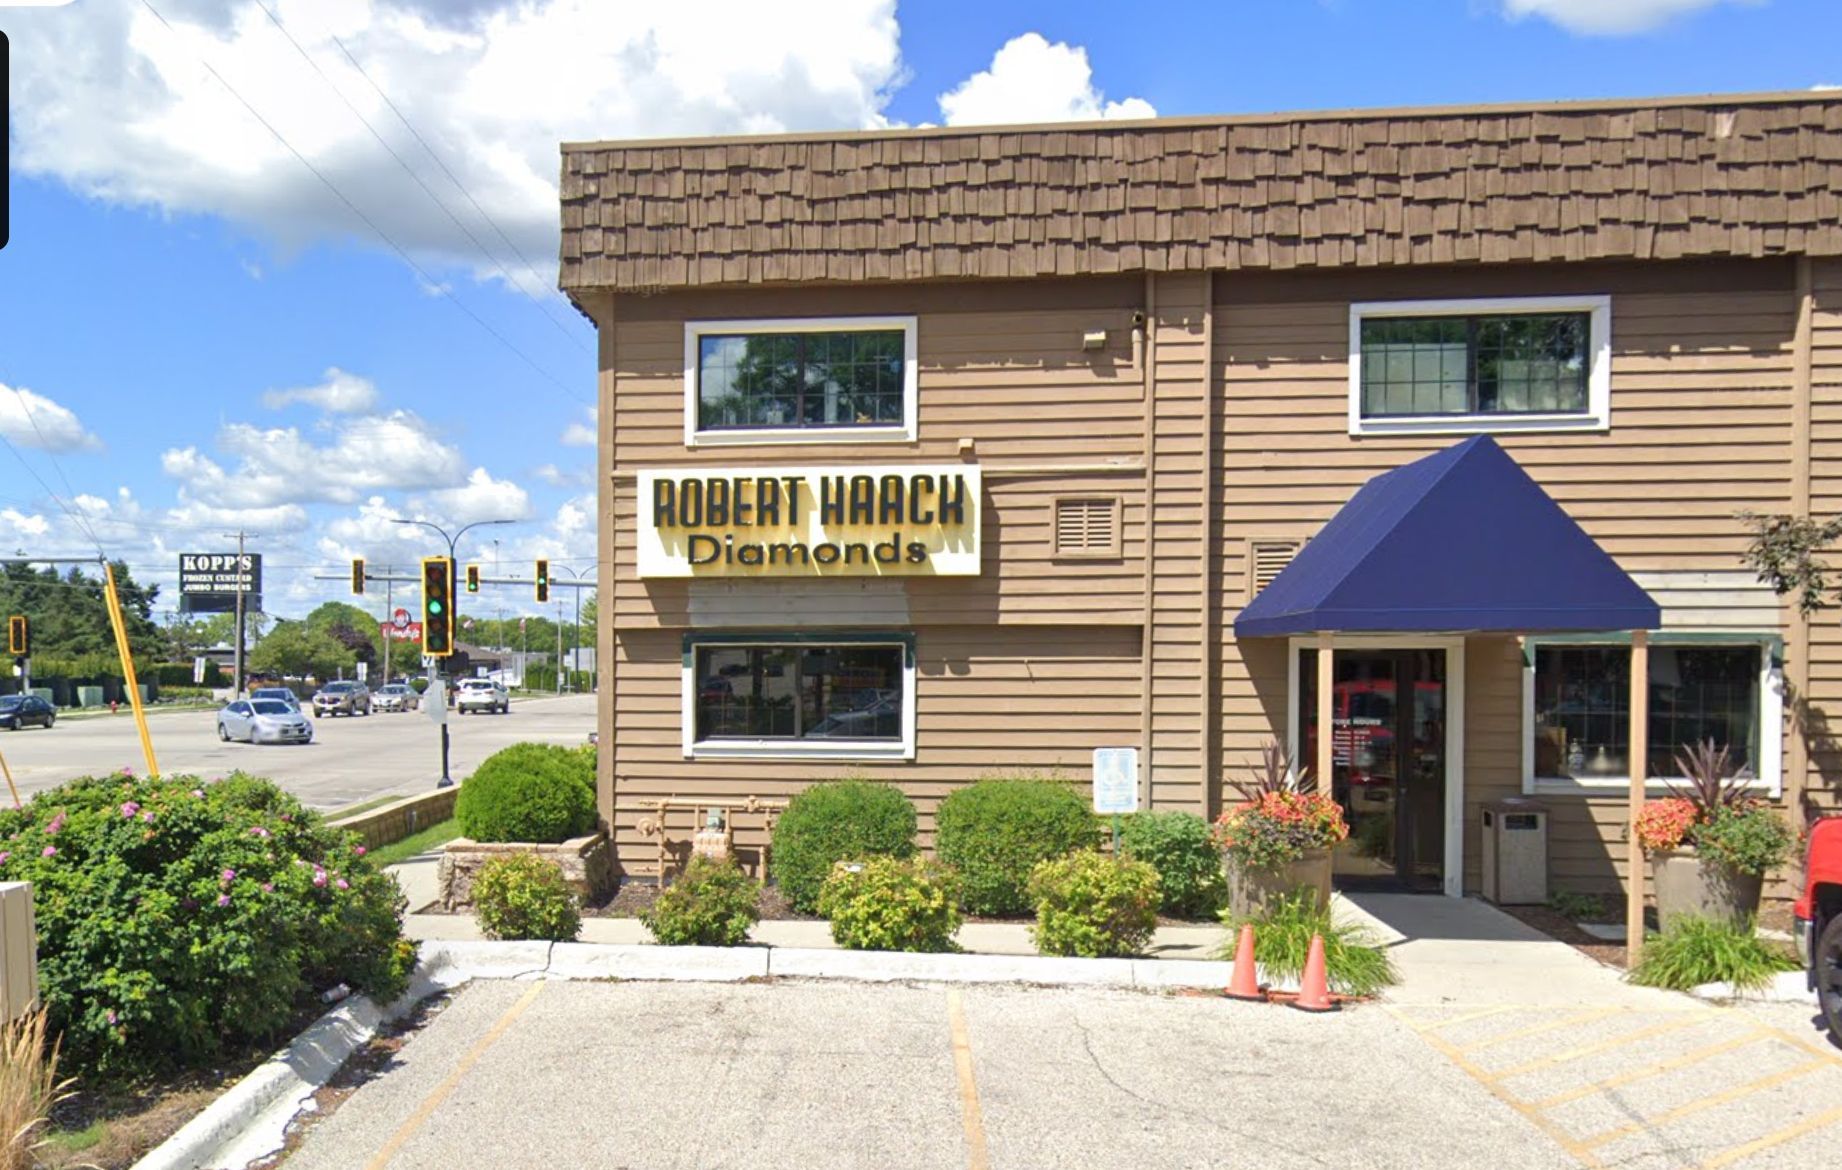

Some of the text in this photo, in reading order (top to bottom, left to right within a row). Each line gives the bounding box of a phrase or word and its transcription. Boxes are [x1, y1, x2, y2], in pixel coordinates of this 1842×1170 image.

[653, 474, 964, 528] ROBERT HAACK
[687, 532, 928, 566] Diamonds
[183, 555, 252, 571] KOPP'S
[183, 574, 213, 583] FROZEN
[183, 584, 211, 592] JUMBO
